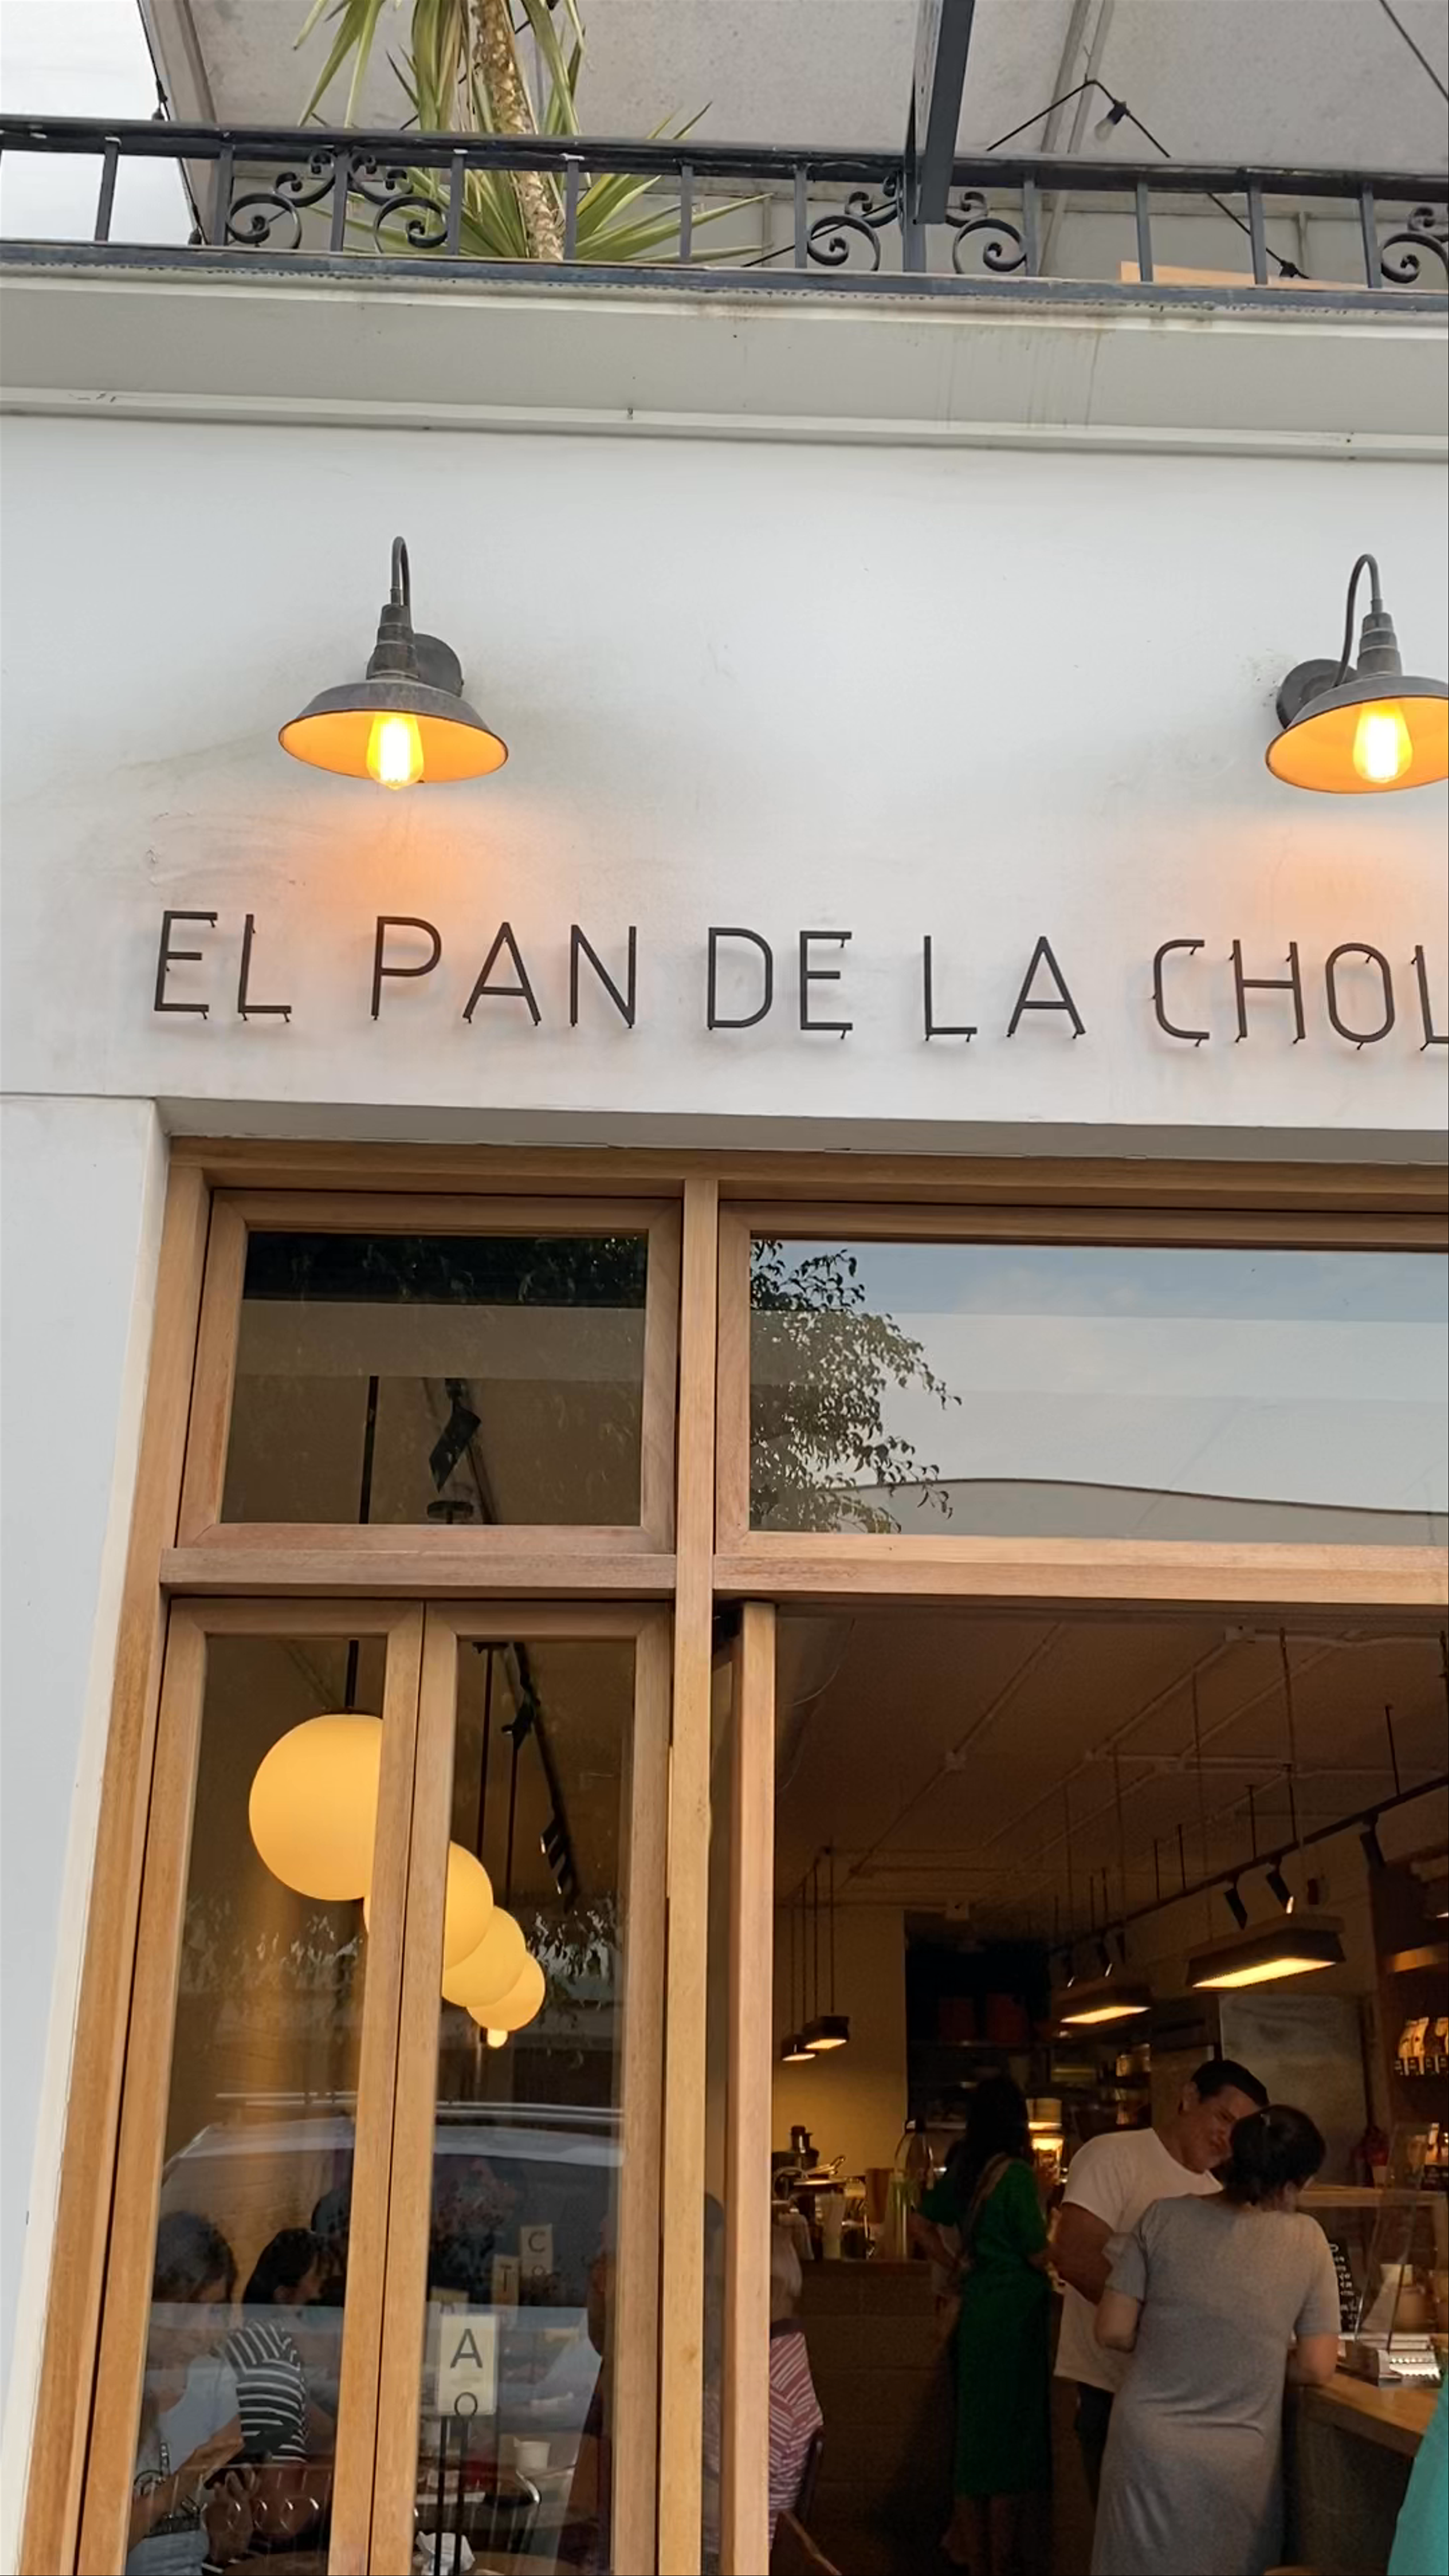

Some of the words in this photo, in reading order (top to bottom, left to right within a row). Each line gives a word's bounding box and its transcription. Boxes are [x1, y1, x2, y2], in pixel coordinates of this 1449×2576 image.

[154, 910, 292, 1021] EL
[371, 916, 636, 1027] PAN
[707, 927, 853, 1036] DE
[924, 935, 1086, 1040] LA
